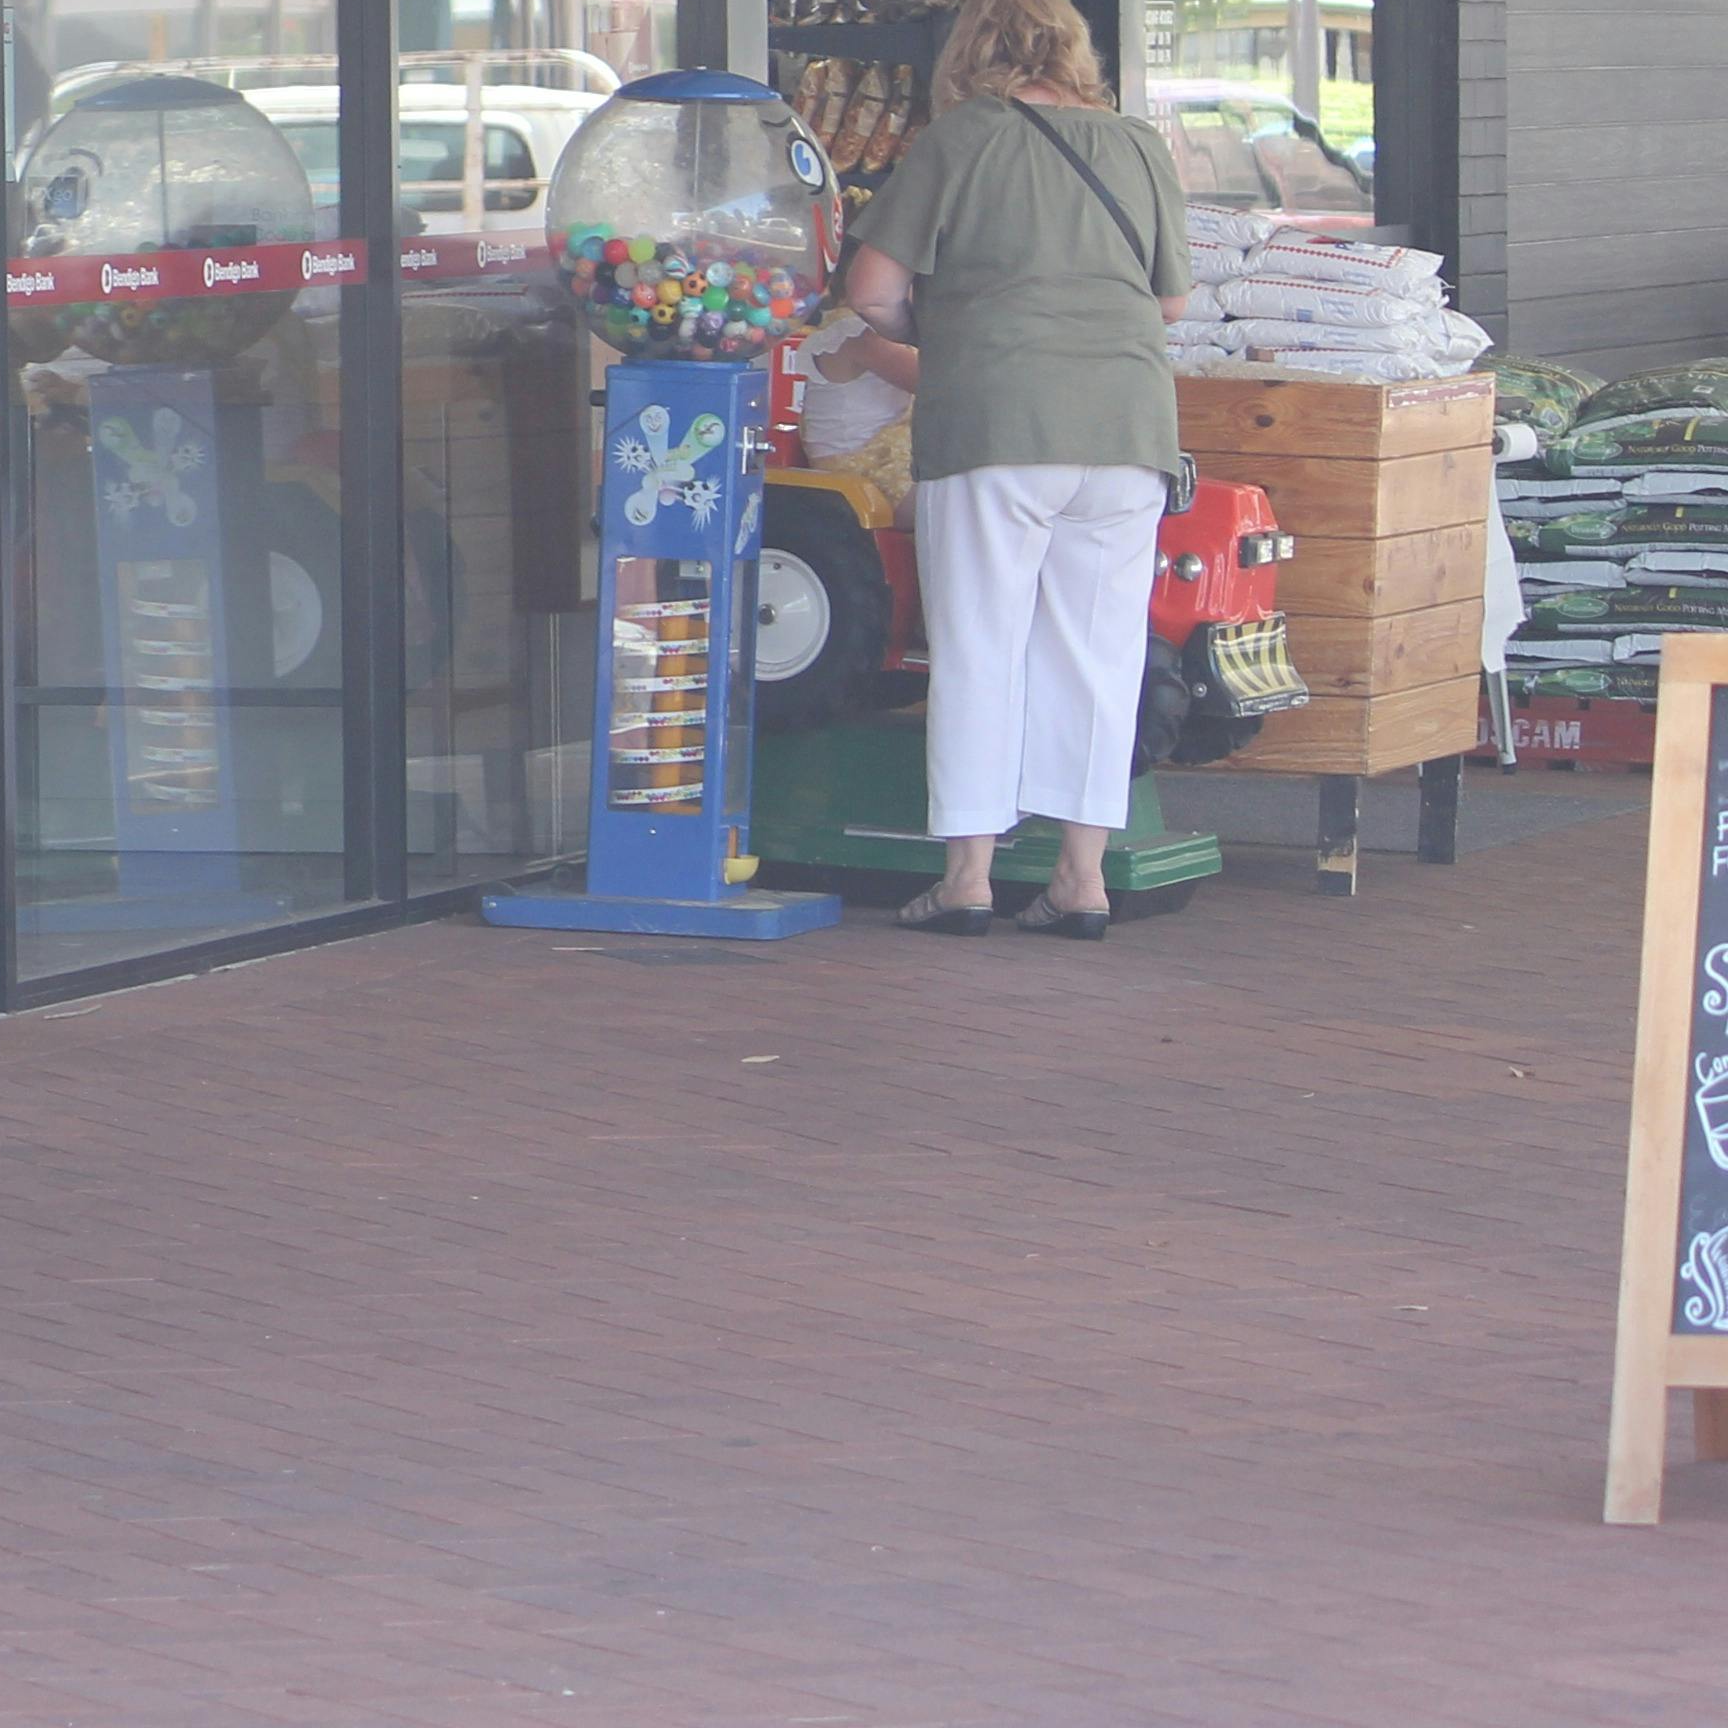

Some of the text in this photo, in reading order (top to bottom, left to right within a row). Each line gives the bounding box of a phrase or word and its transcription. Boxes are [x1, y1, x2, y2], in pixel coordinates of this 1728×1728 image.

[214, 260, 260, 286] Bendigo Bank
[311, 252, 356, 276] Bendigo Bank
[6, 272, 56, 296] Bendigo Bank
[112, 267, 160, 291] Bendigo Bank
